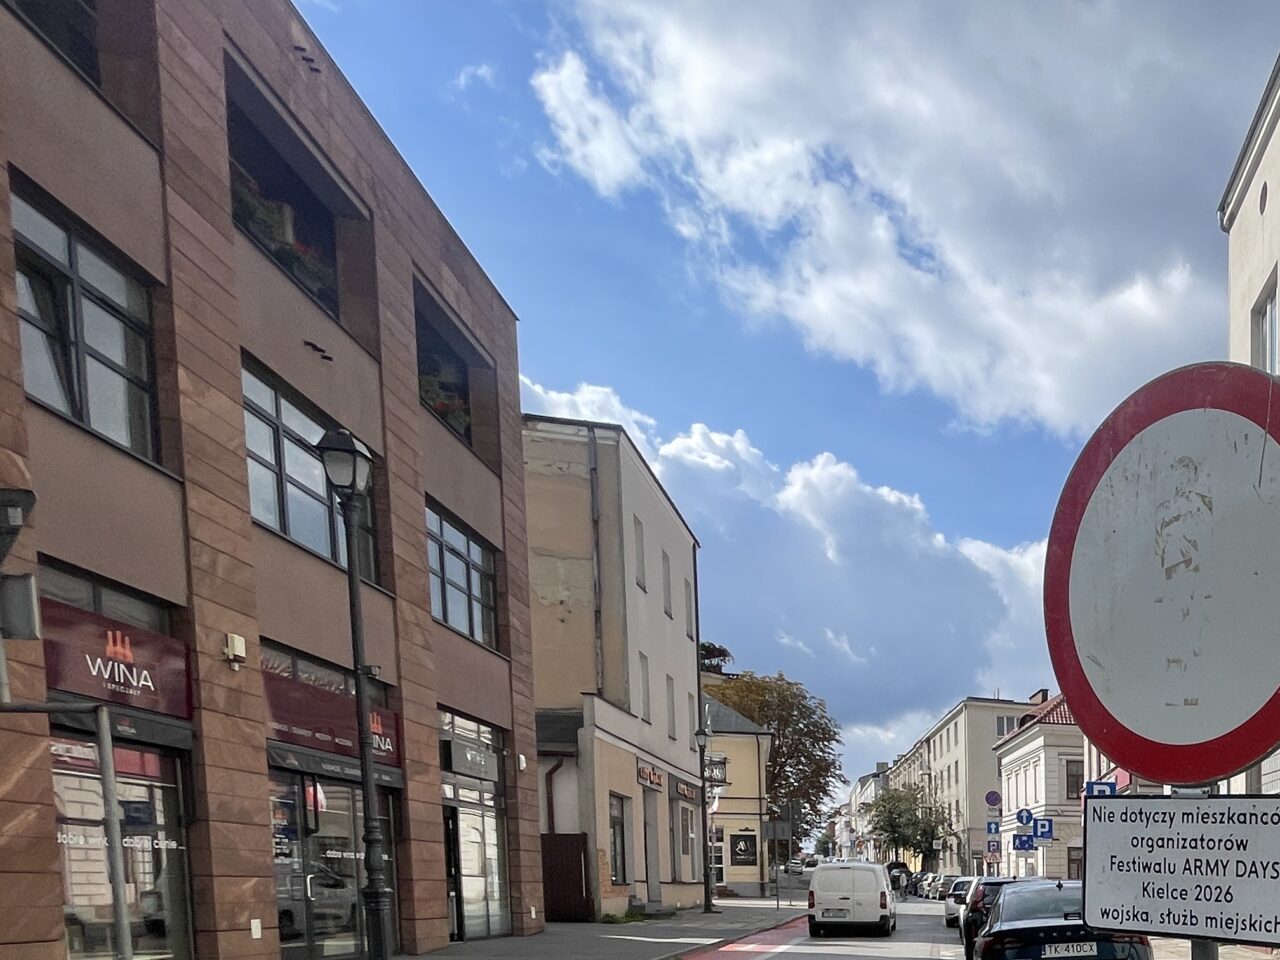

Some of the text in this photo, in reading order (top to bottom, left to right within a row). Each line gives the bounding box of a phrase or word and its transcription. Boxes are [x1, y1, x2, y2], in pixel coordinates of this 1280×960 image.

[85, 654, 155, 691] WINA
[371, 734, 393, 752] INA
[1092, 806, 1115, 823] Nie
[1119, 806, 1176, 829] dotyczy
[1130, 832, 1249, 854] organizatorów
[1110, 855, 1280, 880] Festiwalu ARMY DAYS
[1142, 881, 1234, 903] Kielce 2026
[1100, 905, 1153, 925] wojska,
[1159, 908, 1199, 927] służb
[1048, 943, 1095, 955] TK 410CX
